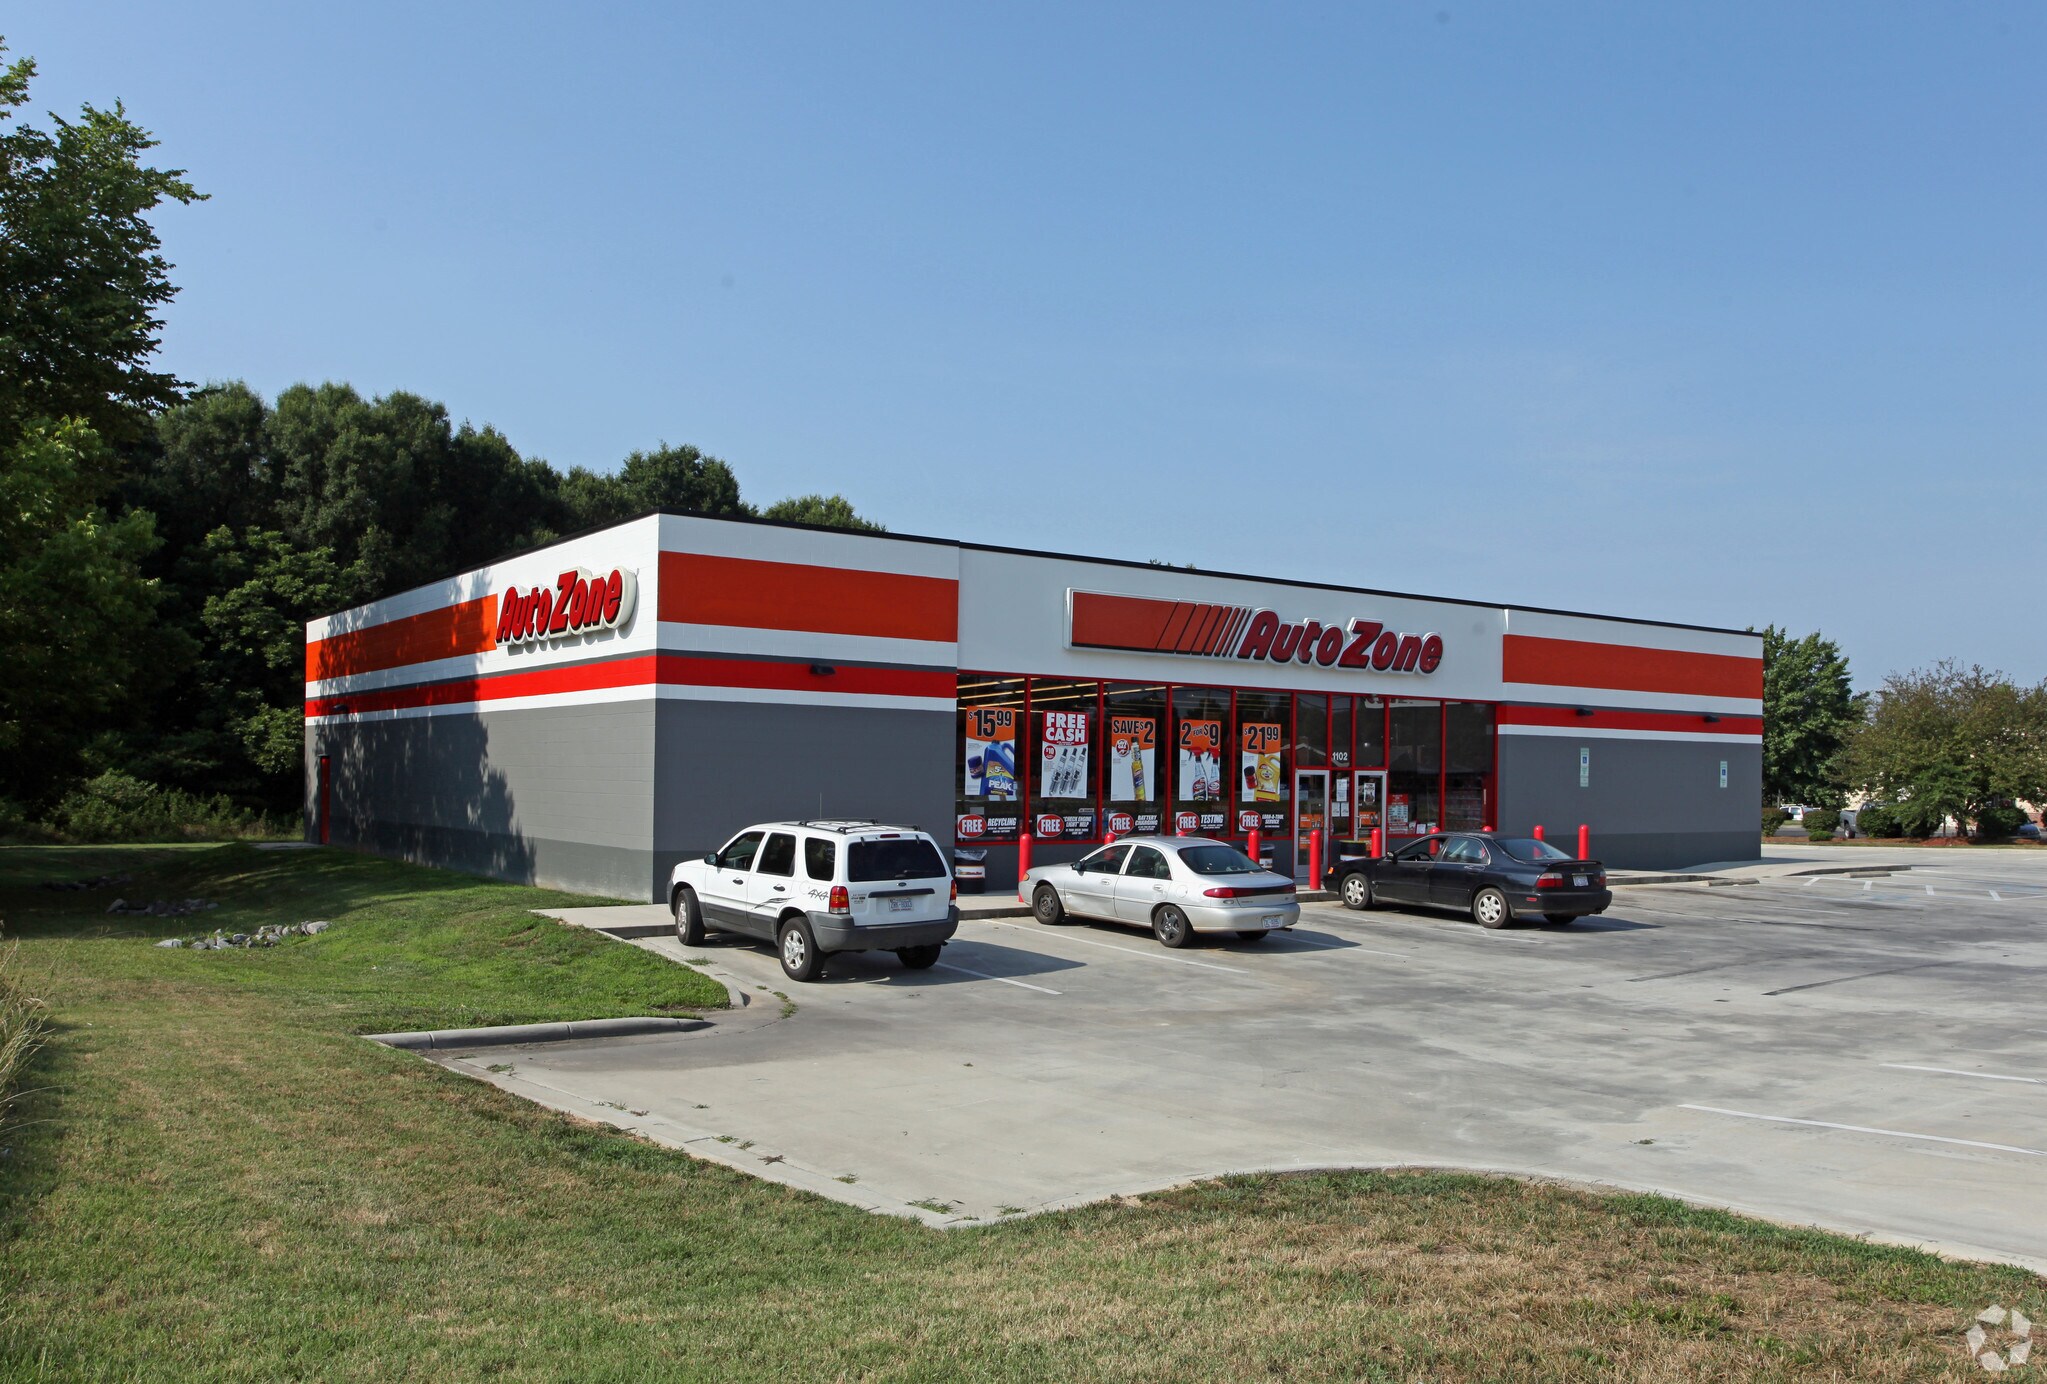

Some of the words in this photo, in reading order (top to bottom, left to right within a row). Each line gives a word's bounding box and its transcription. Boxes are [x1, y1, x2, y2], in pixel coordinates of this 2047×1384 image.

[495, 569, 623, 643] AutoZone
[1236, 610, 1443, 674] AutoZone
[1046, 712, 1086, 729] FREE
[1113, 719, 1139, 734] SAVE
[1045, 727, 1085, 742] CASH
[1181, 722, 1192, 745] 2
[1203, 723, 1219, 746] $9
[1332, 751, 1348, 761] 1102
[988, 779, 1012, 791] PEAK
[987, 817, 1017, 826] RECYCLING
[1040, 819, 1061, 832] FREE
[1112, 817, 1130, 830] FREE
[1179, 816, 1196, 829] FREE
[1200, 814, 1224, 824] TESTING
[1242, 814, 1259, 827] FREE
[961, 819, 983, 833] FREE
